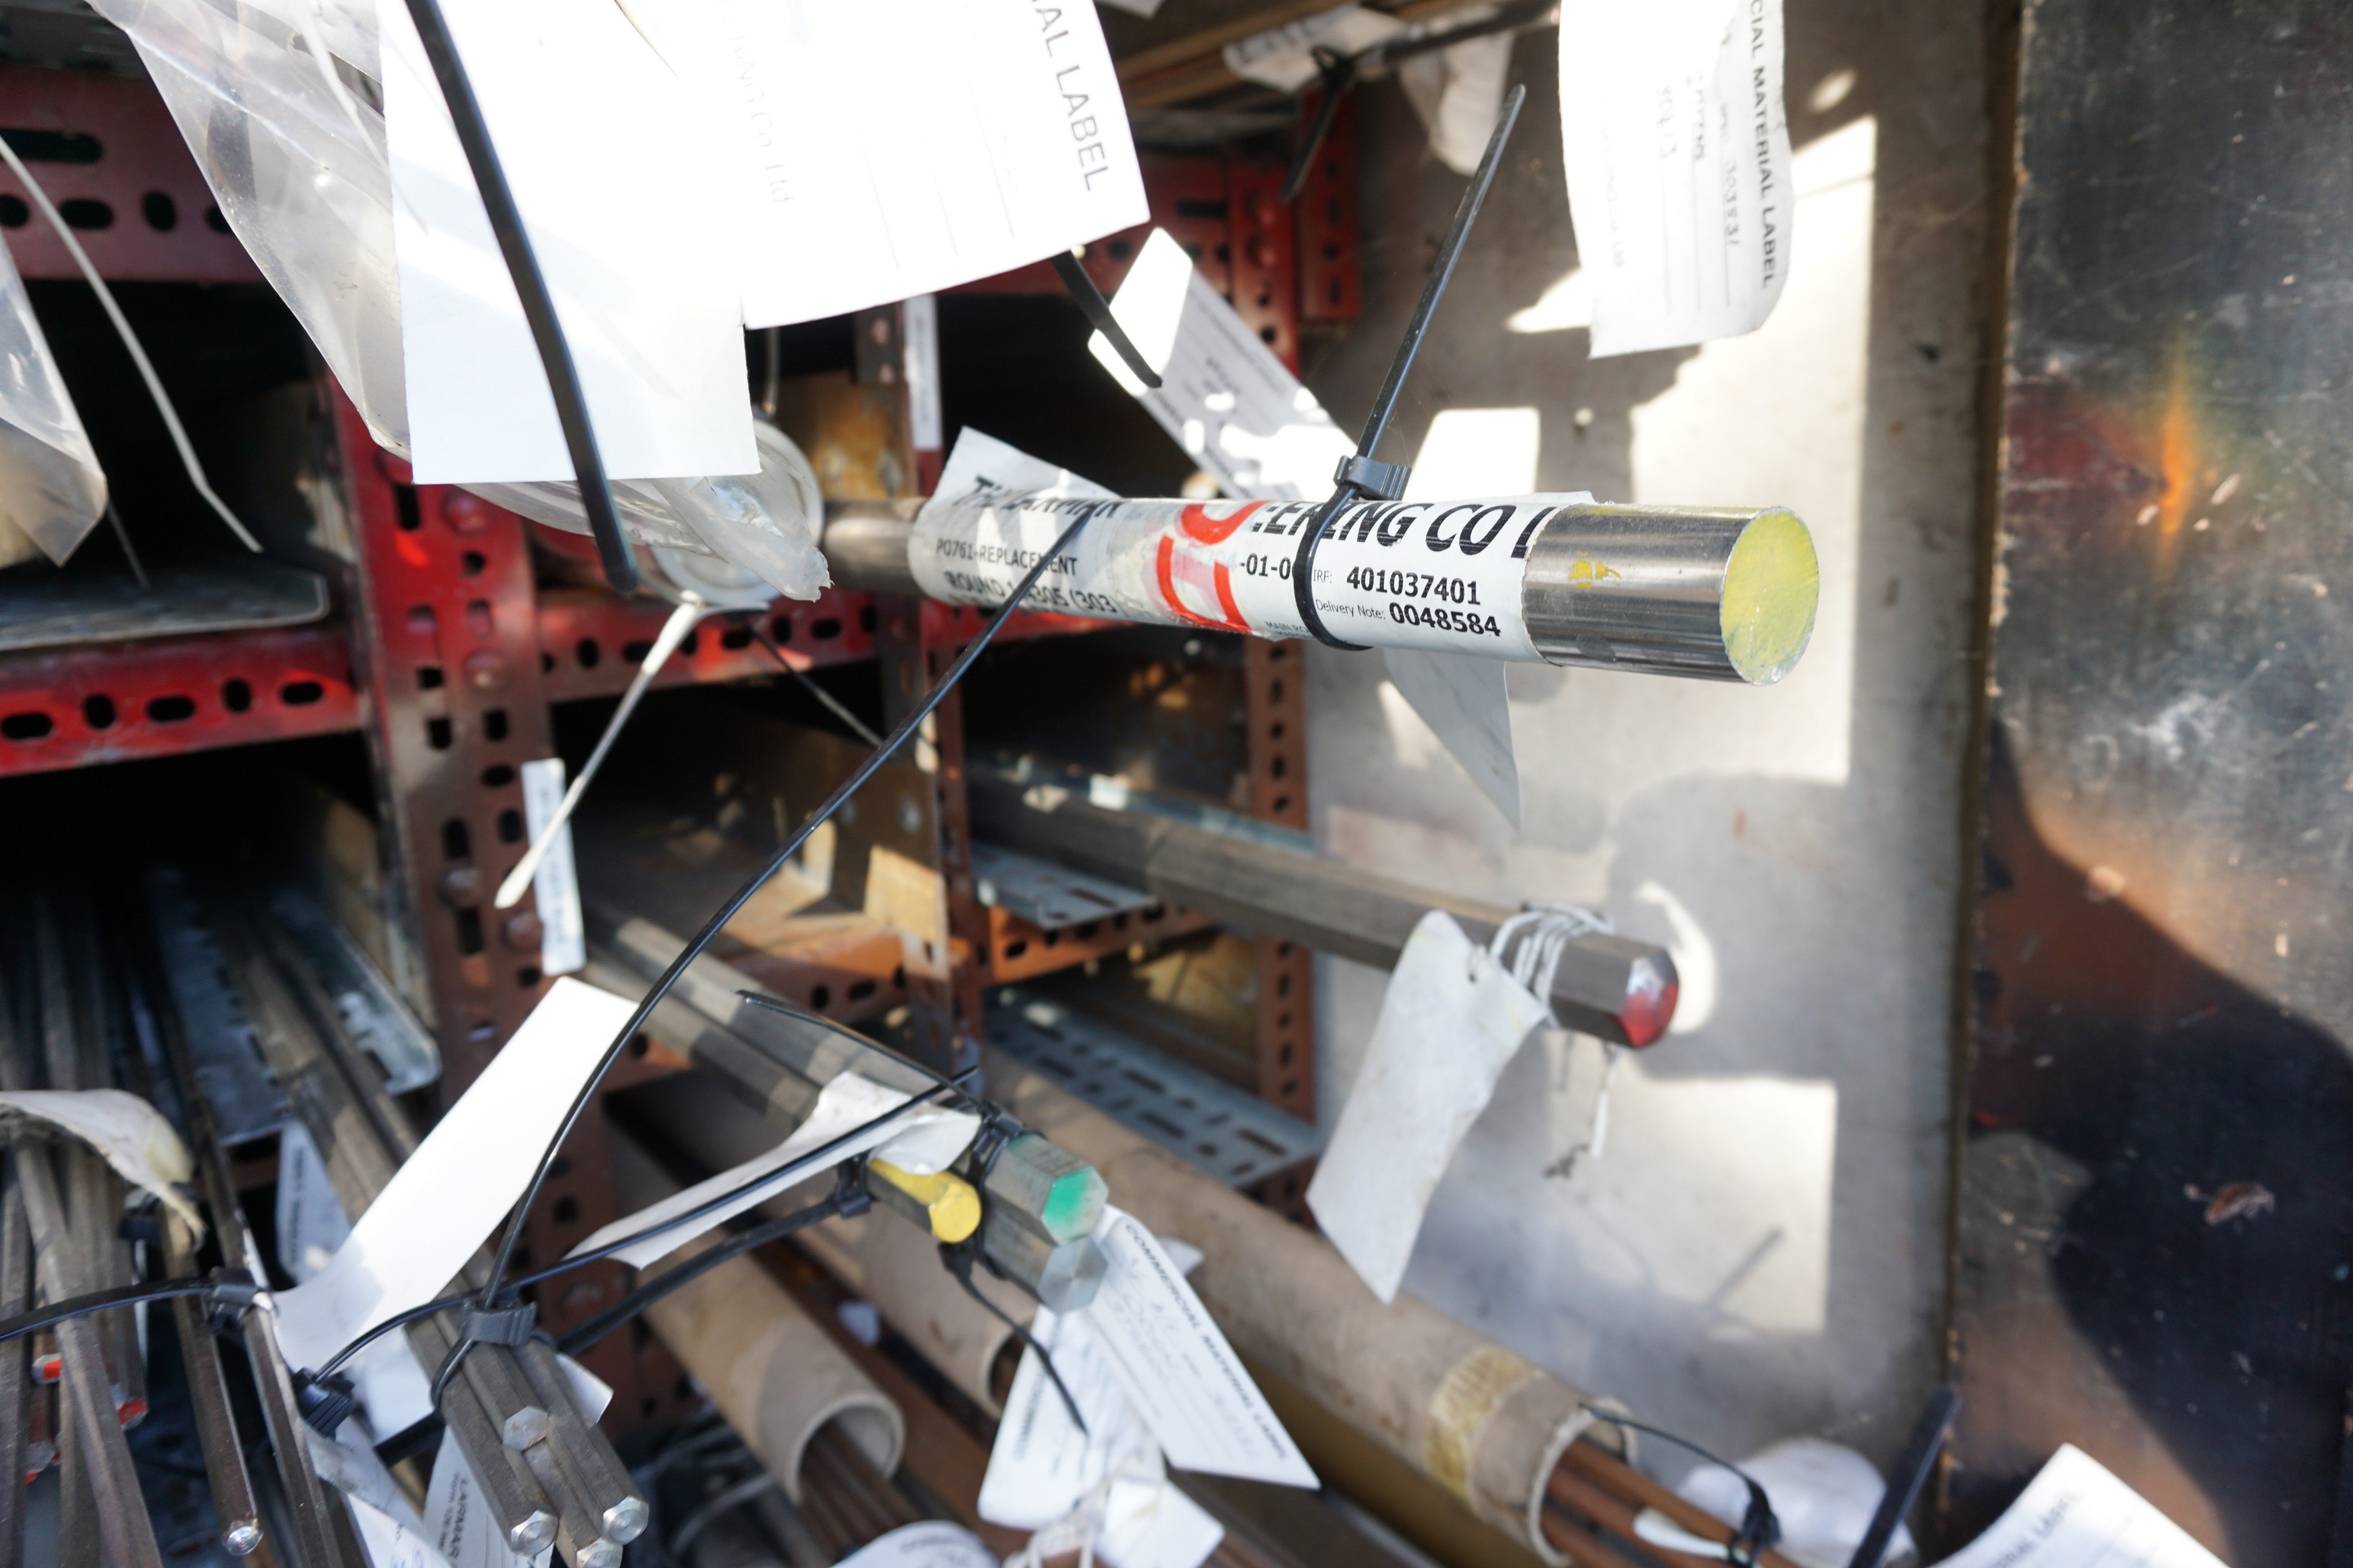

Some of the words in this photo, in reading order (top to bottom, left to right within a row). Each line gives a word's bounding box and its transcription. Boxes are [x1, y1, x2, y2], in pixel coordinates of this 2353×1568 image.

[1055, 64, 1110, 192] LABEL
[1752, 66, 1774, 200] MATERIAL
[1761, 205, 1777, 290] LABEL
[936, 538, 1078, 576] PO761-REPLACEENT
[1425, 504, 1517, 555] CO
[1313, 569, 1333, 584] IRF:
[1346, 566, 1481, 605] 401037401
[1315, 599, 1355, 617] Delivery
[1358, 605, 1386, 620] Note:
[1389, 602, 1501, 637] 0048584
[1124, 1223, 1201, 1330] COMMERCIAL
